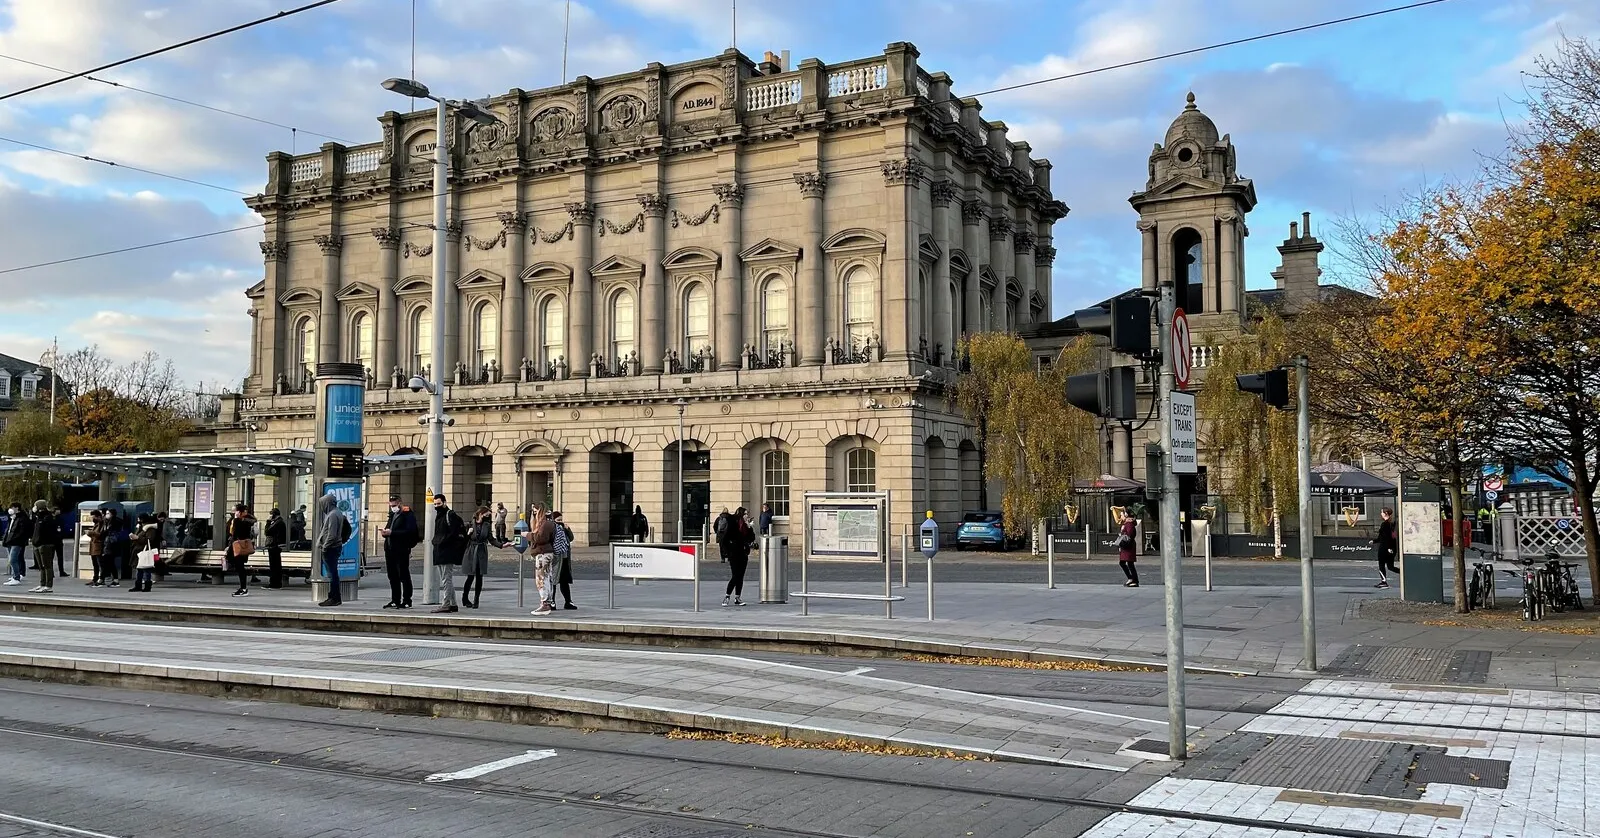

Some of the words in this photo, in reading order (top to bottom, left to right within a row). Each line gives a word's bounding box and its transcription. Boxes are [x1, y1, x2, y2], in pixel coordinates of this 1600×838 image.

[696, 97, 713, 107] 1844
[334, 403, 361, 413] unice
[1173, 403, 1192, 416] EXCEPT
[1174, 419, 1192, 432] TRAMS
[1172, 438, 1180, 448] Och
[1174, 452, 1194, 463] Tramanna
